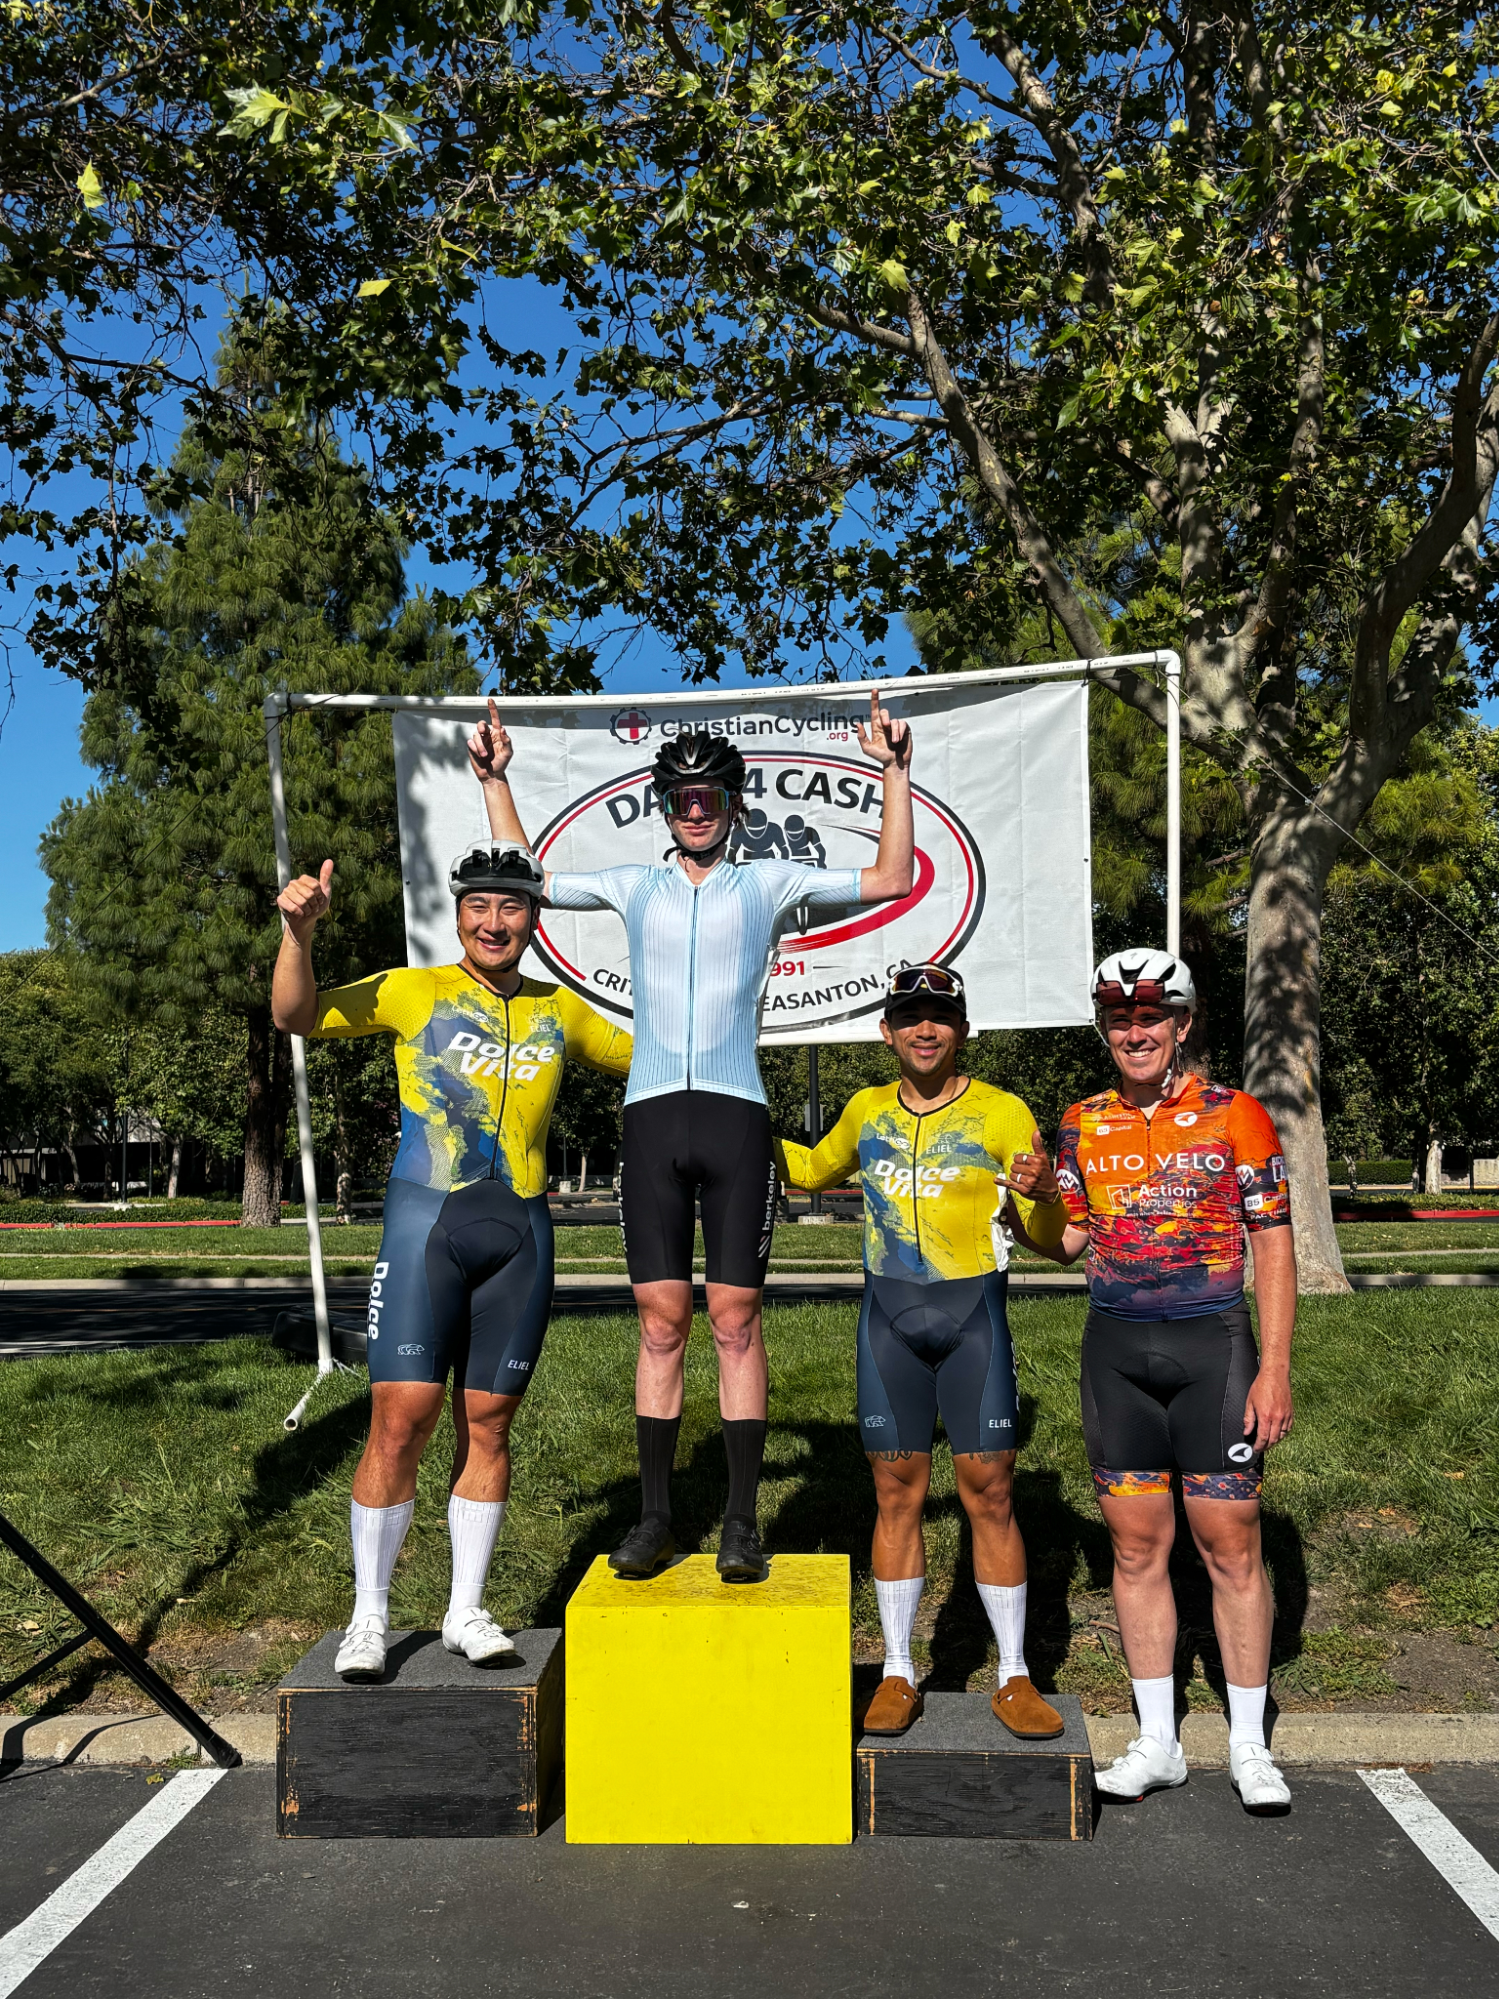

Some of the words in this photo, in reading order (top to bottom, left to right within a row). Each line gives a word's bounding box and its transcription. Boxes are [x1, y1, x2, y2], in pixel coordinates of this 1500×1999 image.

[826, 731, 849, 742] .org
[605, 784, 661, 829] DA
[742, 768, 767, 798] 4
[775, 768, 883, 819] CASH
[770, 960, 804, 977] 991
[763, 974, 885, 1011] EASANTON,
[448, 1031, 555, 1062] Dolce
[460, 1052, 541, 1081] Vita
[926, 1144, 952, 1155] ELIEL
[874, 1159, 960, 1182] Dolce
[1085, 1154, 1145, 1176] ALTO
[1155, 1152, 1225, 1172] VELO
[762, 1161, 776, 1230] berkeley
[883, 1177, 944, 1198] Vita
[1138, 1183, 1197, 1197] Action
[369, 1261, 389, 1340] Dolce
[507, 1359, 530, 1370] ELIEL
[988, 1418, 1012, 1428] ELIEL
